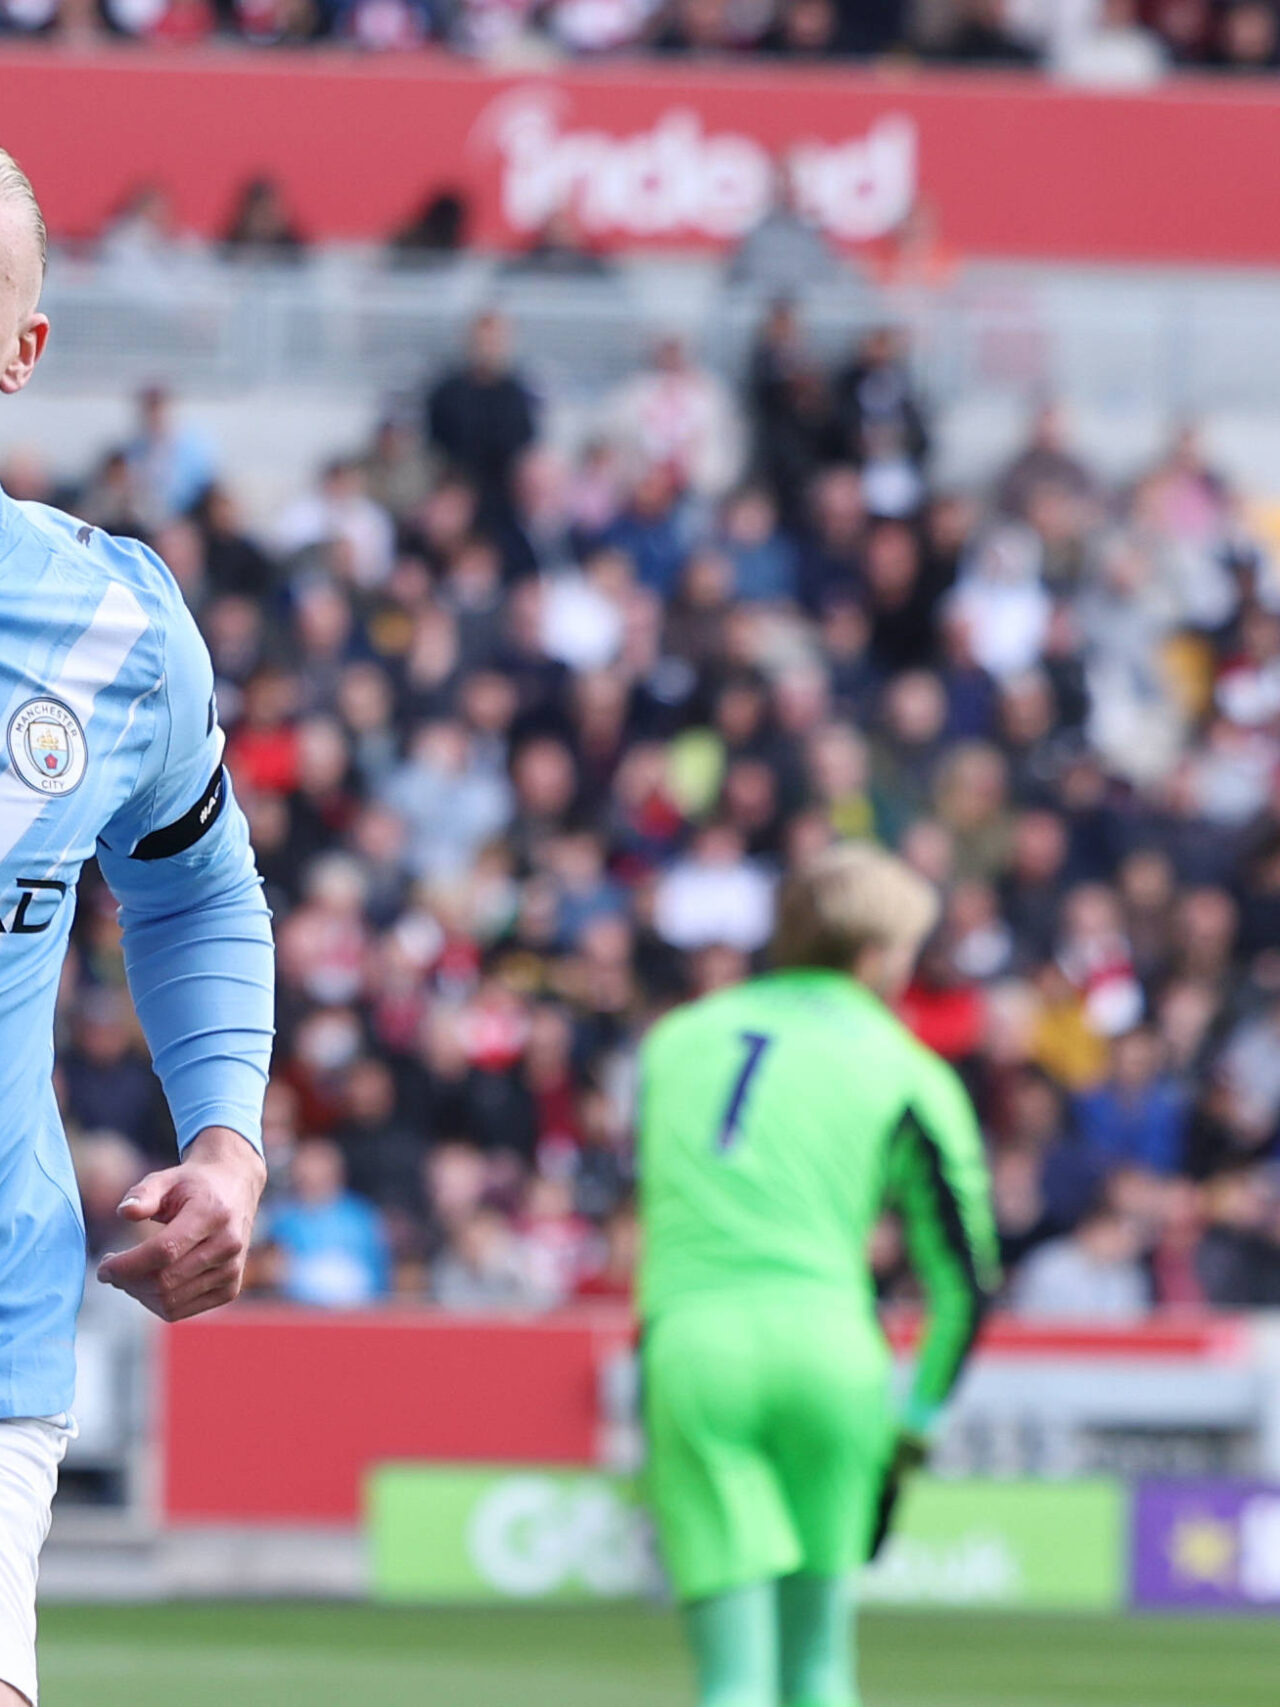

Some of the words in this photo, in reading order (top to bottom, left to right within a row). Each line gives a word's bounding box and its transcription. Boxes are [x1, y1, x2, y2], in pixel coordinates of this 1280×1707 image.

[15, 705, 78, 738] MANCHESTER
[41, 779, 65, 790] CITY
[718, 1030, 770, 1150] 1
